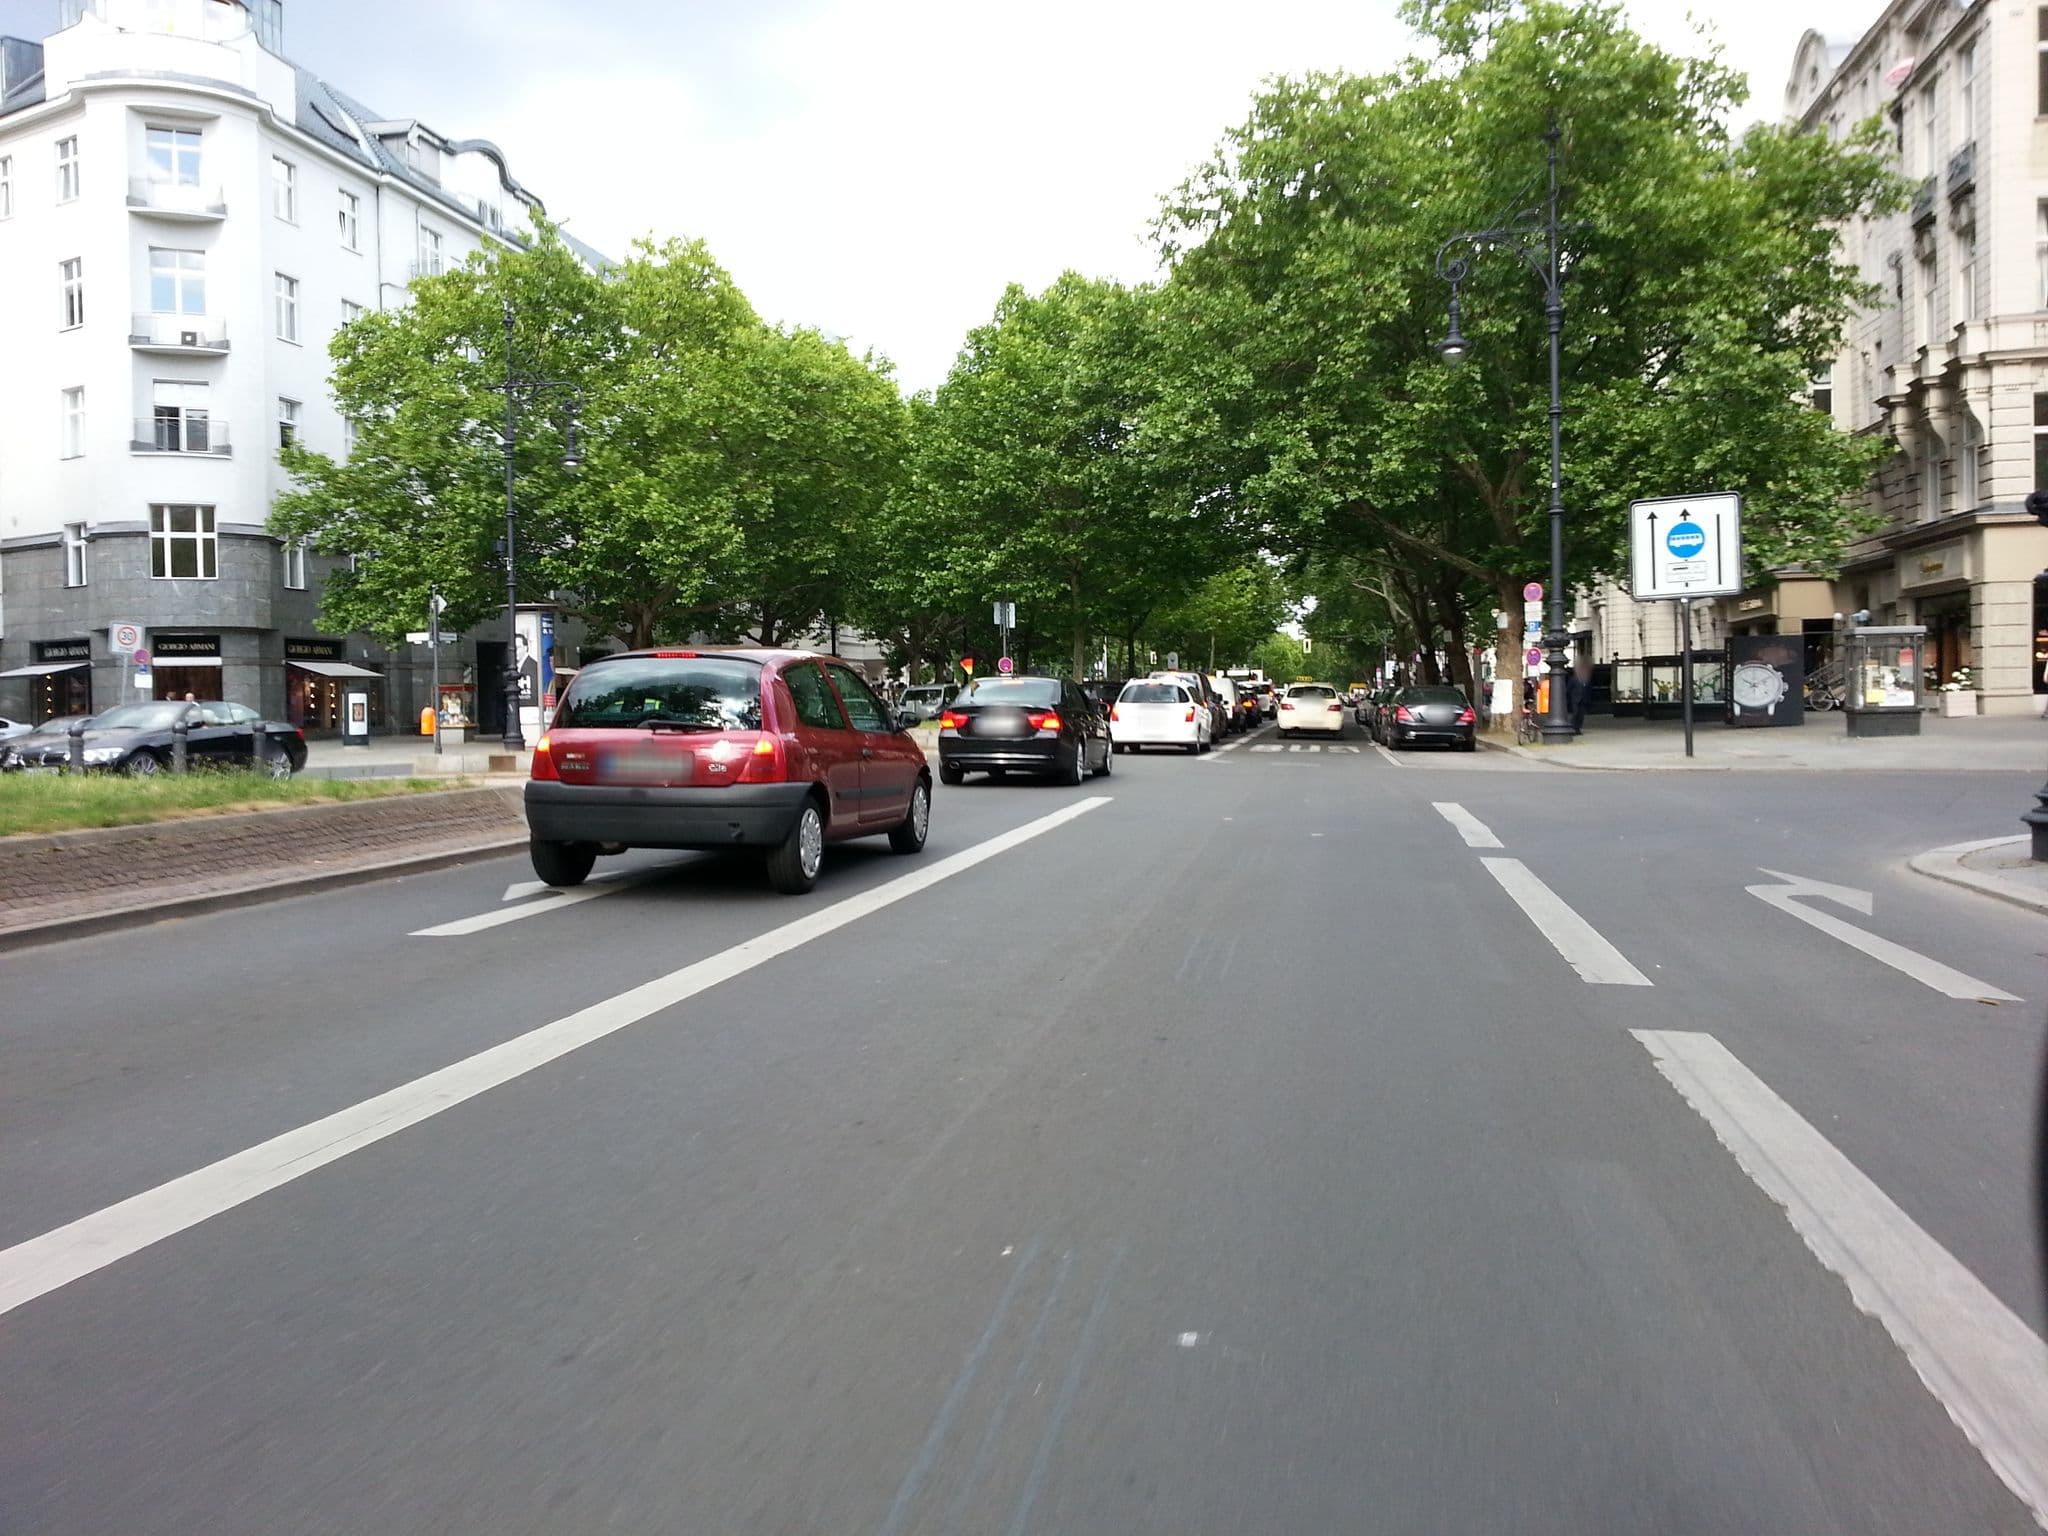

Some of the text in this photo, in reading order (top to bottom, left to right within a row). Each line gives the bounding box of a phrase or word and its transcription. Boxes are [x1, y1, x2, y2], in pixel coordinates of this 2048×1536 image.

[121, 631, 133, 641] 30
[158, 643, 216, 651] GIORGIO ARMANI
[1248, 744, 1360, 753] BUS
